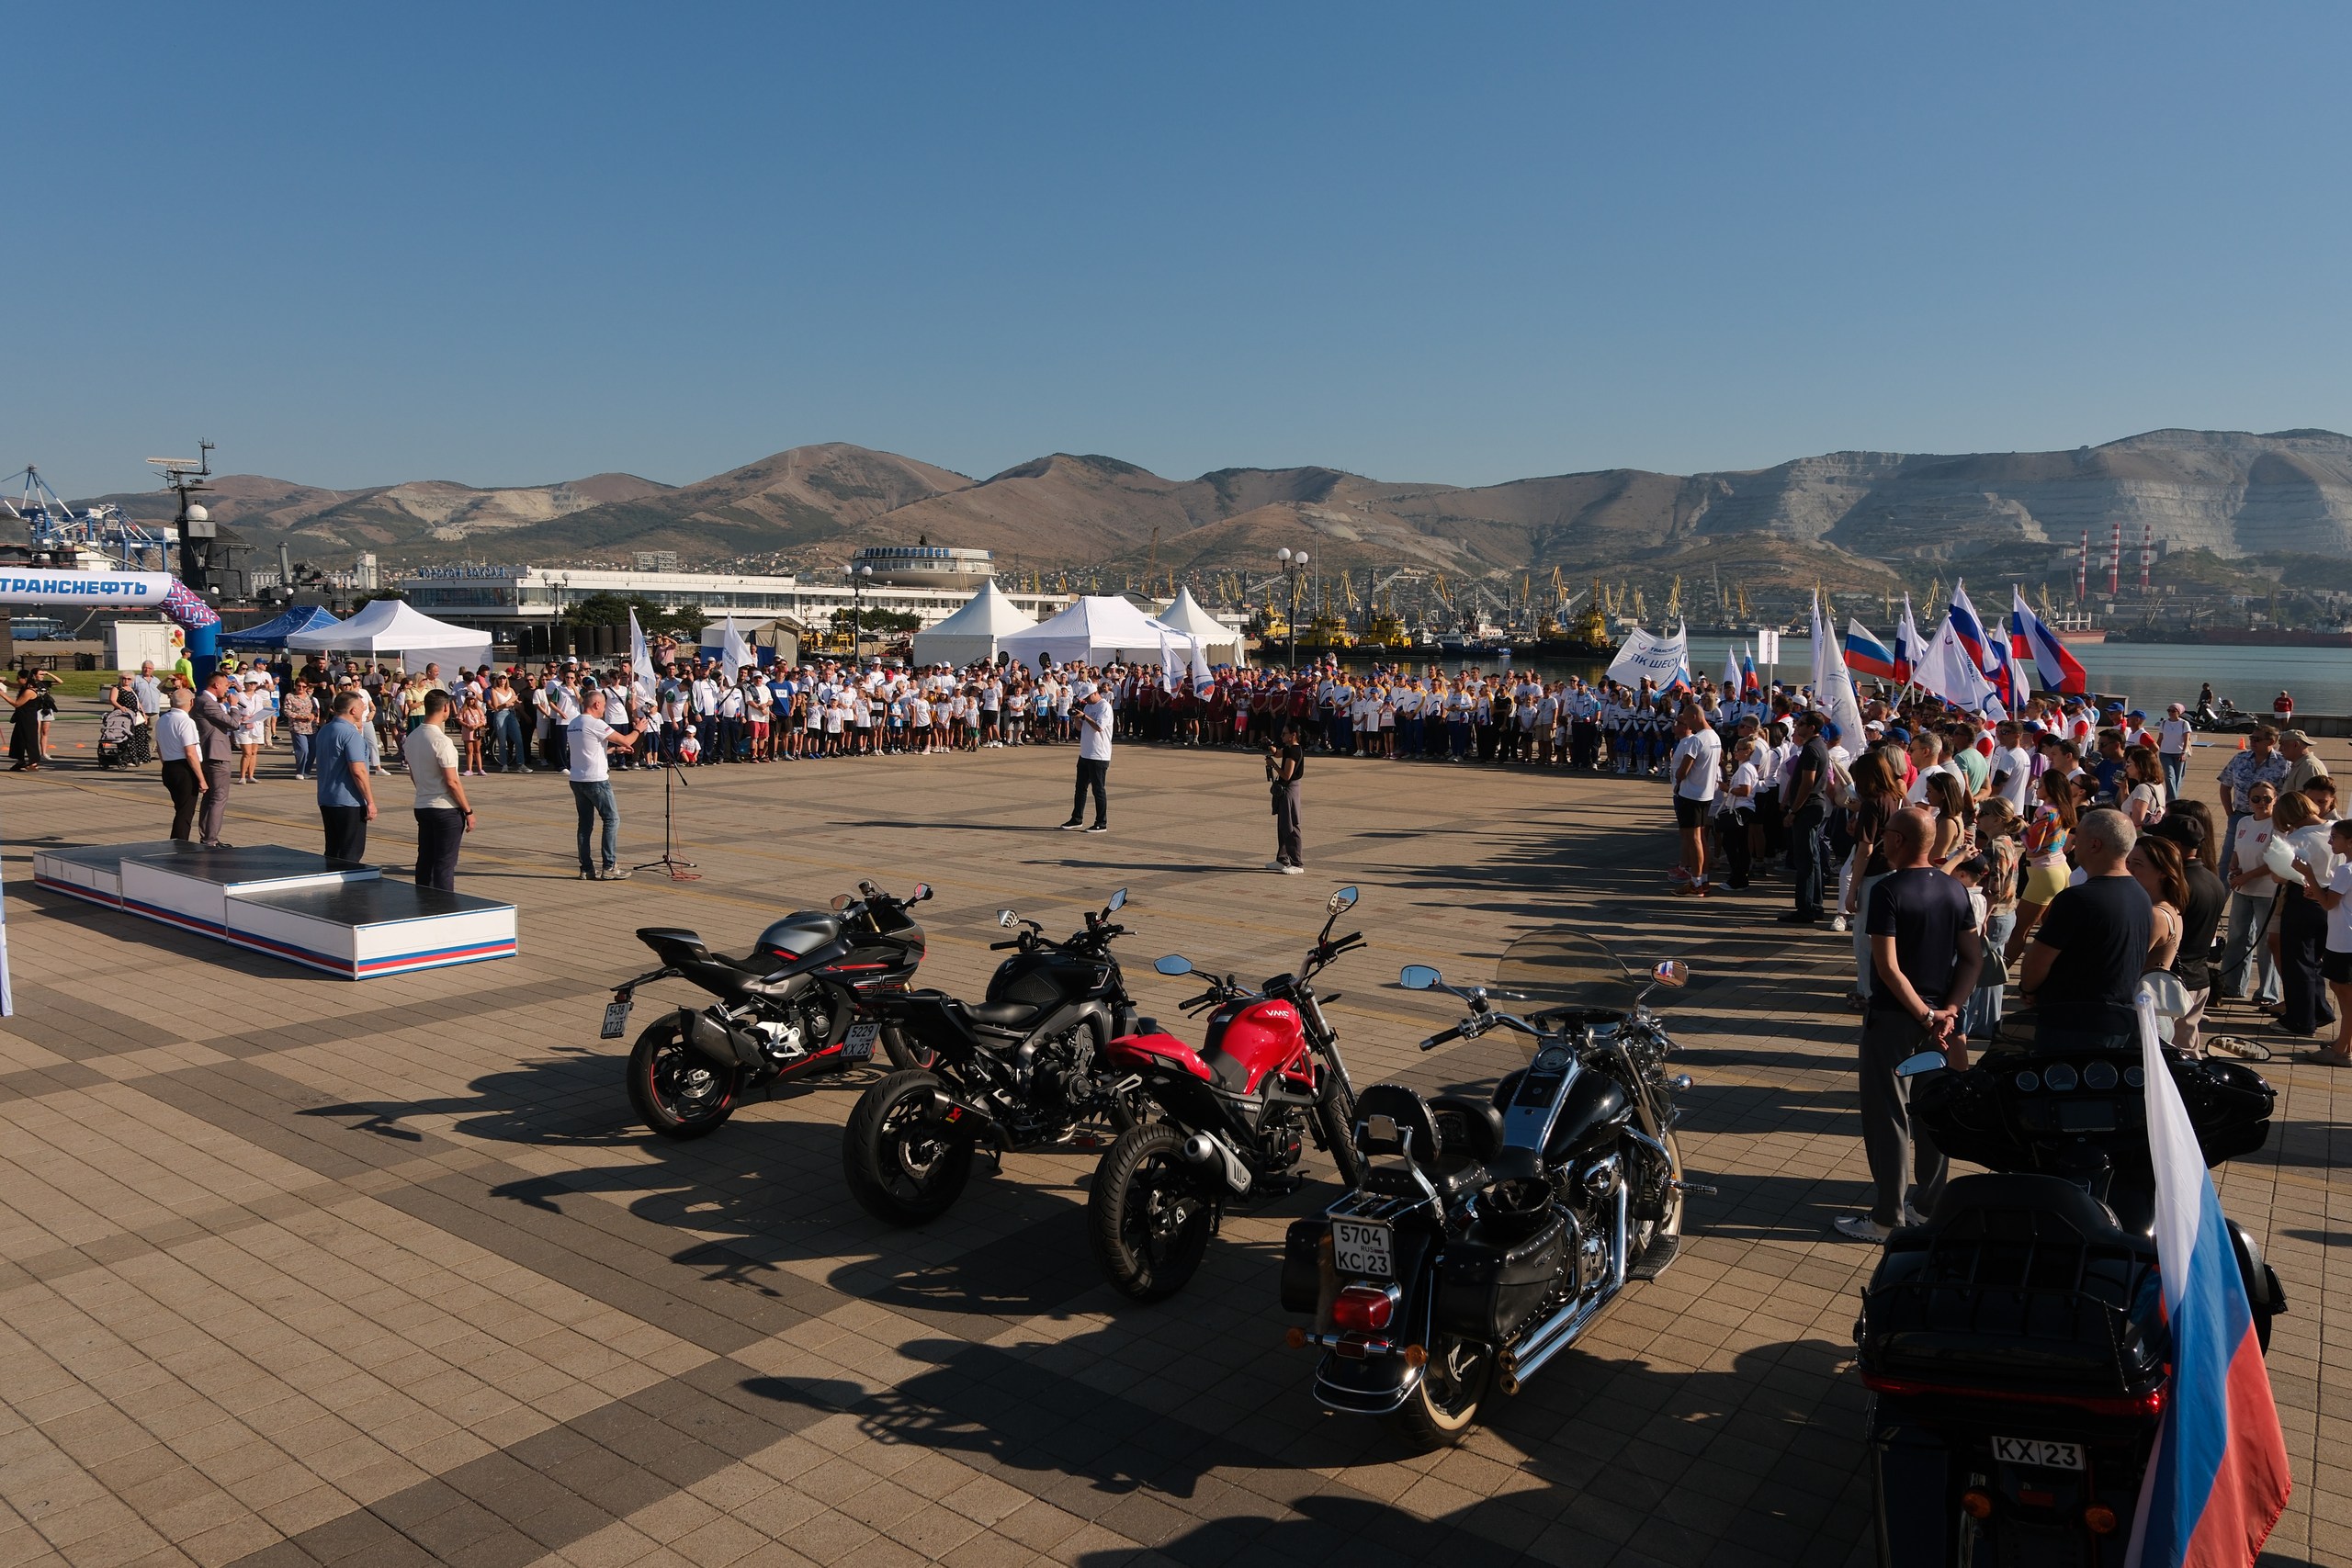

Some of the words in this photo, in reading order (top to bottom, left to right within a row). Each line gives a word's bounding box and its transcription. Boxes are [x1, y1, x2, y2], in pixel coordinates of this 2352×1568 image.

[0, 579, 147, 595] ТРАНСНЕФТЬ
[1630, 653, 1648, 666] ПК
[614, 1021, 624, 1032] 23
[852, 1025, 875, 1038] 5229
[857, 1043, 870, 1055] 23
[1340, 1225, 1382, 1247] 5704
[1361, 1245, 1374, 1253] RUS
[1367, 1255, 1387, 1273] 23
[2043, 1443, 2077, 1467] 23
